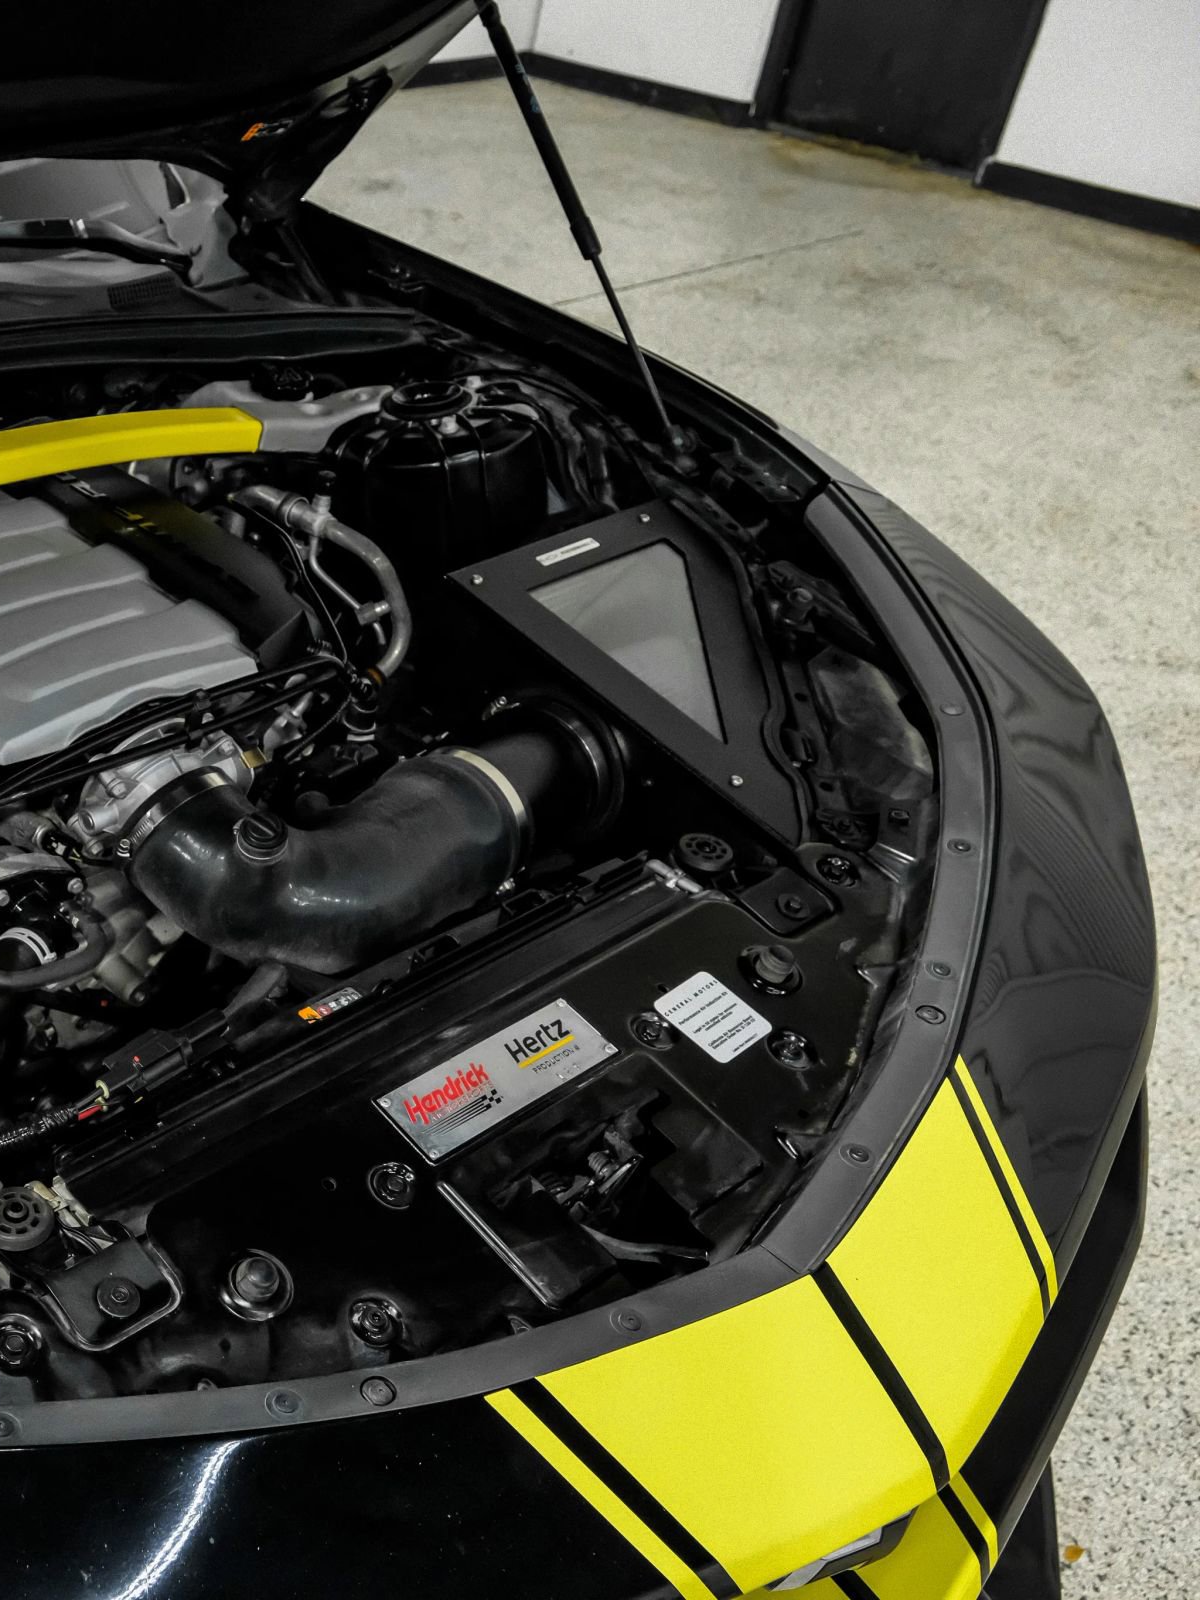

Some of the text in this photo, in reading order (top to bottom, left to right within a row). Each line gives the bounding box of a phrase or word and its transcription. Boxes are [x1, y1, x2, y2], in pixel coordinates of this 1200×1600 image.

[664, 979, 718, 1017] GENERAL MOTORS
[504, 1019, 570, 1063] Hertz
[532, 1047, 575, 1074] PRODUCTION
[403, 1062, 490, 1125] Hendrick
